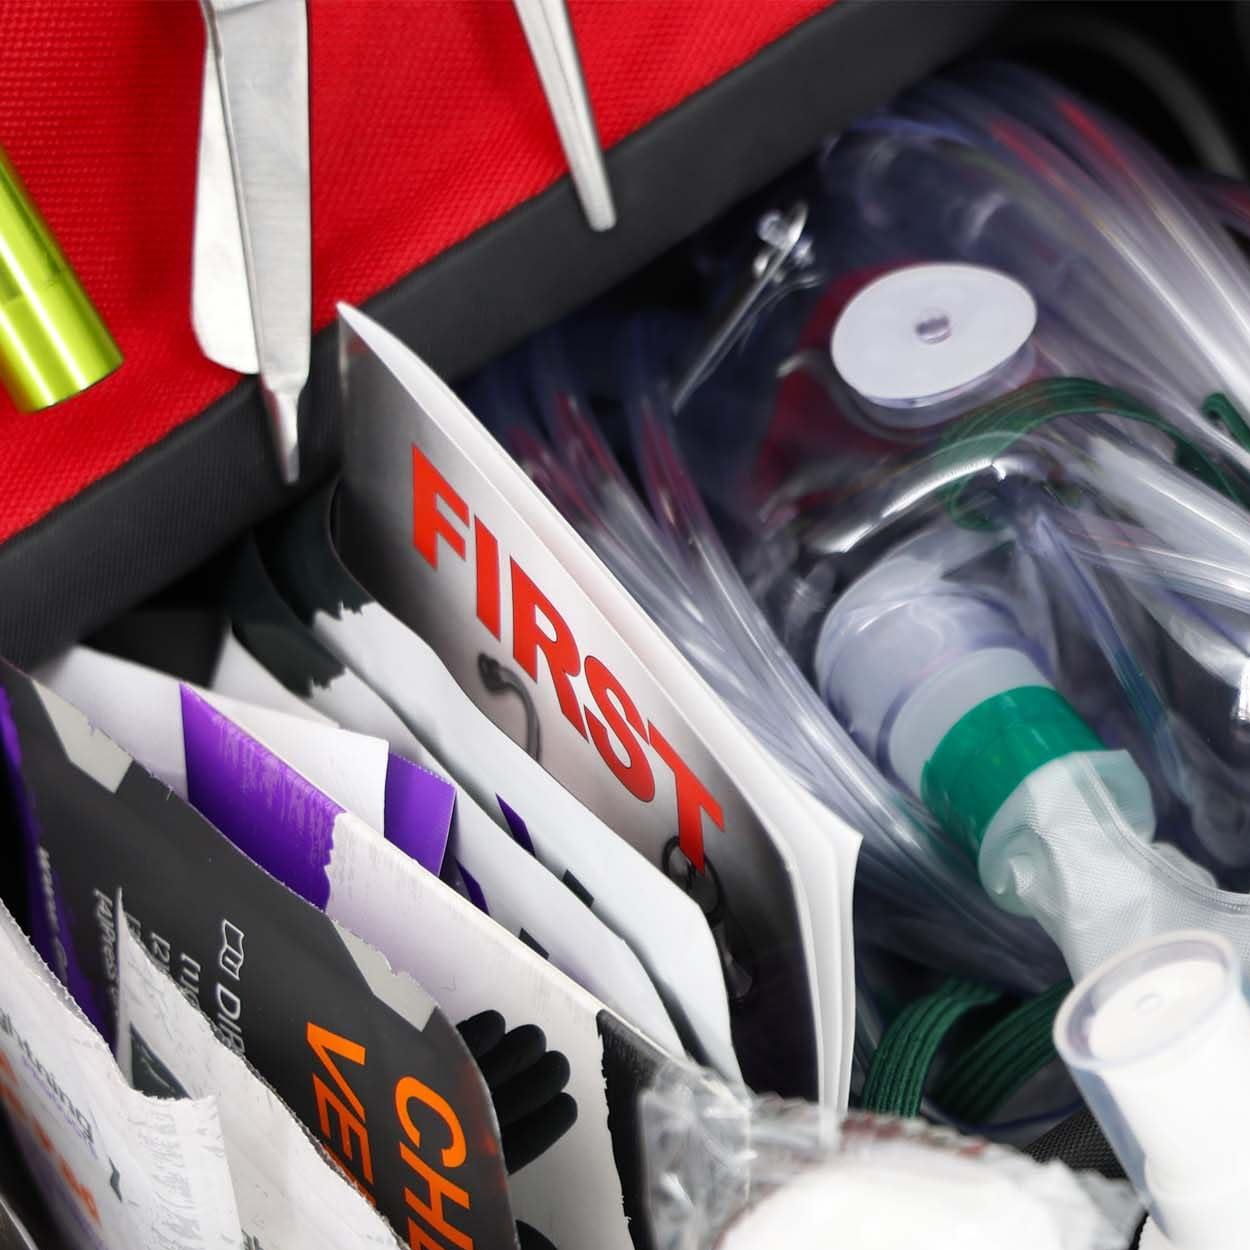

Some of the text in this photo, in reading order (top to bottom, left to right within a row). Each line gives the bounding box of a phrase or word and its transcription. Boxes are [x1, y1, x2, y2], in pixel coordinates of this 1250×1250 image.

[410, 442, 726, 875] FIRST
[212, 982, 247, 1059] DIR
[305, 1021, 376, 1207] VE
